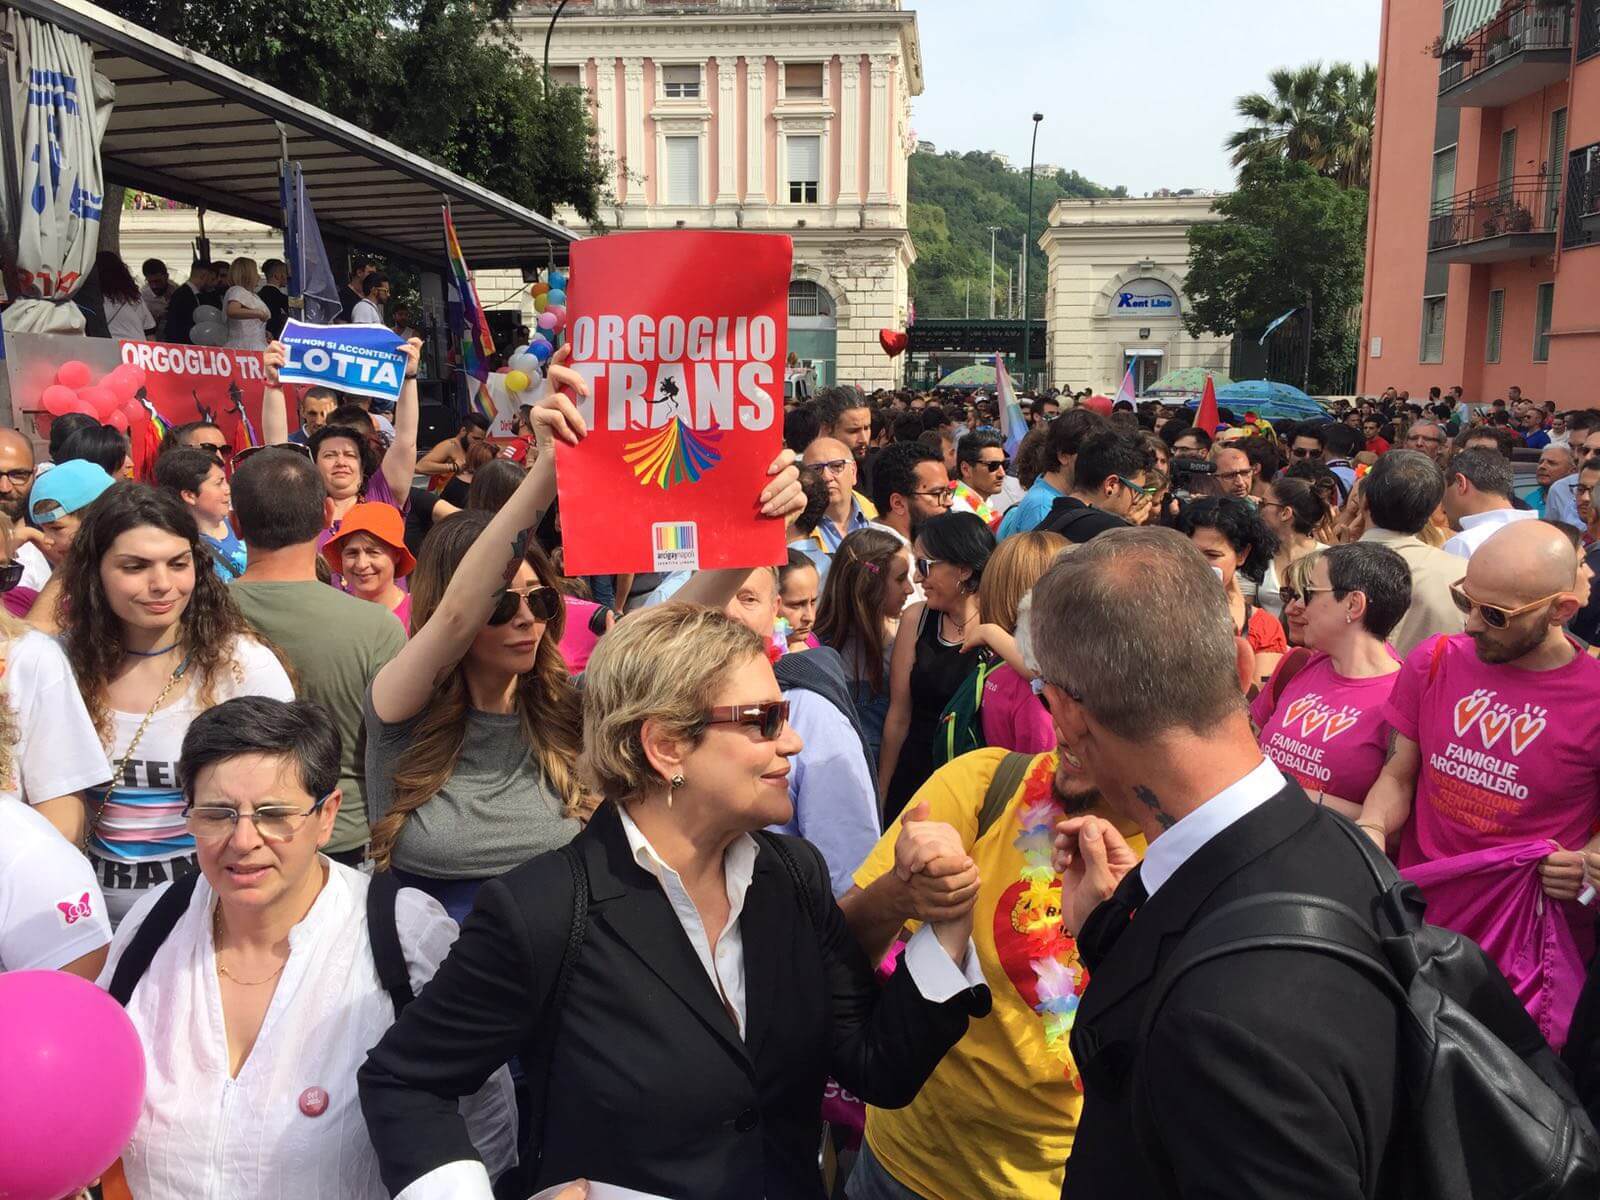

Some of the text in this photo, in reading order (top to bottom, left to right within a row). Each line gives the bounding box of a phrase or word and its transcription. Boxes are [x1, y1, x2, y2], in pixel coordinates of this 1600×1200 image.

[1117, 292, 1173, 308] Rent Line
[302, 337, 325, 347] NON
[326, 341, 337, 350] SI
[338, 343, 404, 363] ACCONTENTA
[572, 314, 777, 362] ORGOGLIO
[121, 342, 264, 379] ORGOGLIO TR
[284, 344, 398, 388] LOTTA
[570, 362, 775, 431] TRANS
[1260, 742, 1331, 782] ARCOBALENO
[1270, 732, 1325, 763] FAMIGLIE
[1445, 742, 1520, 780] FAMIGLIE
[1430, 753, 1528, 800] ARCOBALENO
